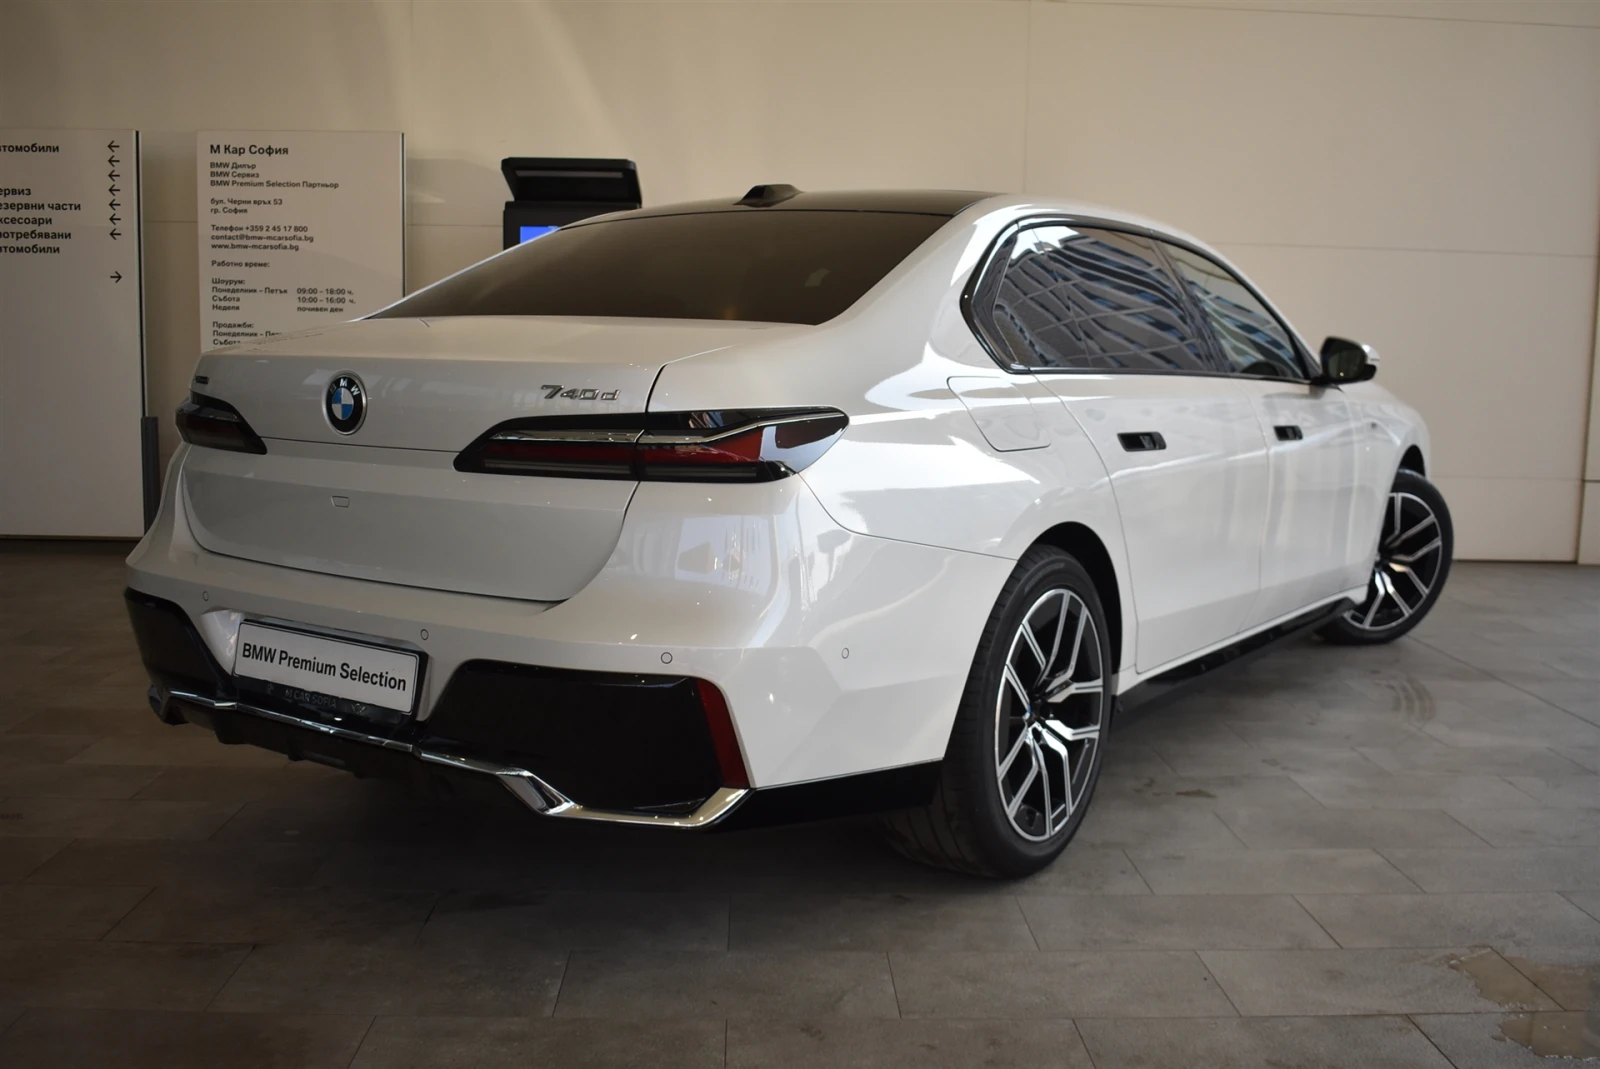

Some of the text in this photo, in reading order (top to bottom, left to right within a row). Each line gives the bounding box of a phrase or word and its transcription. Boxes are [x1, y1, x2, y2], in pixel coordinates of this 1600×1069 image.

[224, 145, 246, 156] Кар
[249, 144, 289, 157] София
[231, 162, 257, 170] Дилър
[231, 171, 260, 179] Сервиз
[265, 180, 301, 188] Selection
[302, 181, 340, 190] Партньор
[210, 198, 283, 207] бул. Черни връх 53
[48, 203, 81, 211] части
[222, 207, 248, 215] София
[211, 224, 244, 232] Телефон
[293, 225, 308, 233] 800
[0, 230, 72, 241] отребявани
[211, 233, 314, 243] contact@bmw-mcarsofia.bg
[211, 243, 300, 252] www.bmw-mcarsofia.bg
[211, 260, 270, 269] Работно време:
[211, 278, 246, 286] Шоурум:
[212, 287, 258, 295] Понеделник
[297, 287, 318, 295] 09:00
[212, 295, 241, 303] Събота
[297, 296, 318, 304] 10:00
[325, 296, 346, 304] 16:00
[212, 304, 240, 312] Неделя
[212, 321, 254, 329] Продажби:
[212, 330, 258, 338] Понеделник
[330, 378, 360, 396] BMW
[540, 384, 621, 401] 740d
[242, 642, 407, 692] BMW Premium Selection
[293, 690, 311, 702] CAR
[311, 694, 337, 709] SOFIA
